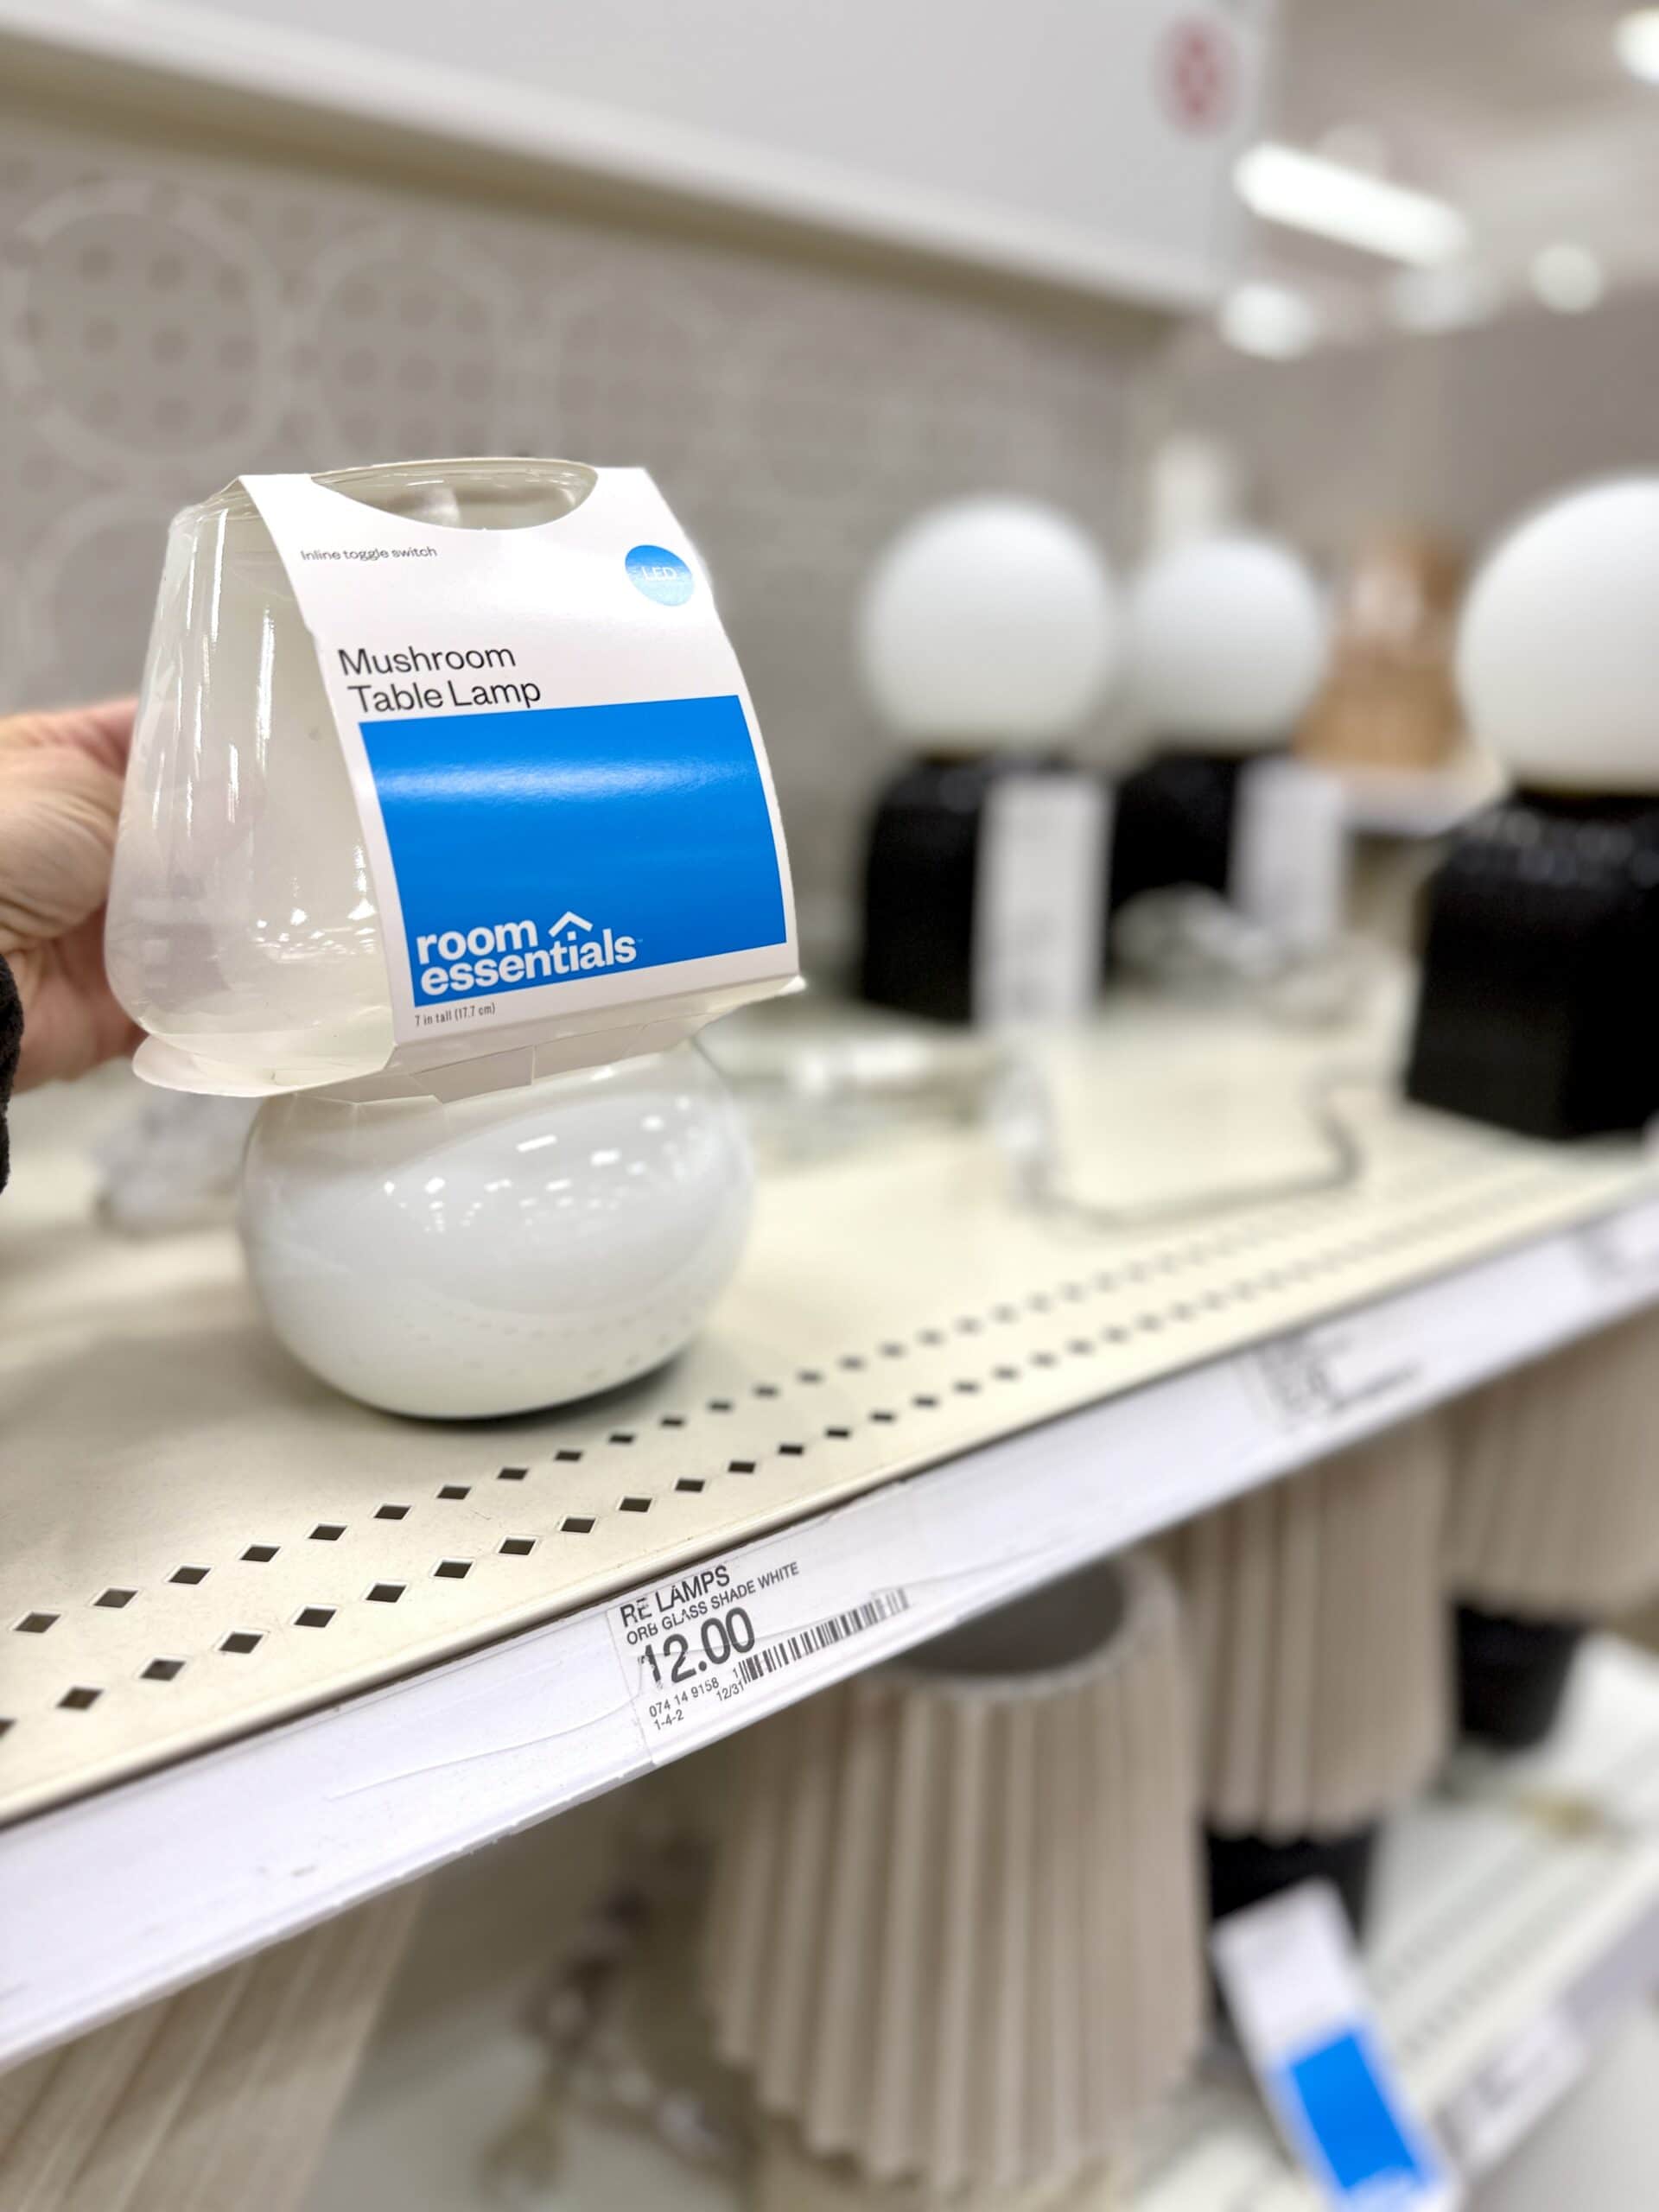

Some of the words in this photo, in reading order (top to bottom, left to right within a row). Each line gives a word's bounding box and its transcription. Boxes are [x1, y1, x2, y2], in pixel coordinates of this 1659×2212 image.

[301, 550, 341, 561] Inline
[343, 548, 389, 562] toggle
[391, 546, 438, 558] switch
[641, 566, 677, 582] LED
[338, 646, 516, 676] Mushroom
[347, 682, 443, 713] Table
[448, 679, 541, 709] Lamp
[416, 919, 538, 964] room
[421, 928, 637, 995] essentials
[423, 1014, 433, 1026] in
[435, 1009, 452, 1023] tall
[454, 1005, 475, 1021] (17.7
[479, 1002, 496, 1016] cm)
[620, 1599, 652, 1628] RE
[656, 1565, 730, 1612] LAMPS
[626, 1623, 658, 1645] ORB
[662, 1601, 708, 1630] GLASS
[710, 1580, 756, 1610] SHADE
[757, 1561, 800, 1589] WHITE
[638, 1606, 755, 1685] 12.00
[649, 1699, 671, 1717] 074
[674, 1691, 688, 1706] 14
[691, 1676, 720, 1698] 9158
[716, 1679, 744, 1701] 12/31
[654, 1709, 684, 1730] 1-4-2
